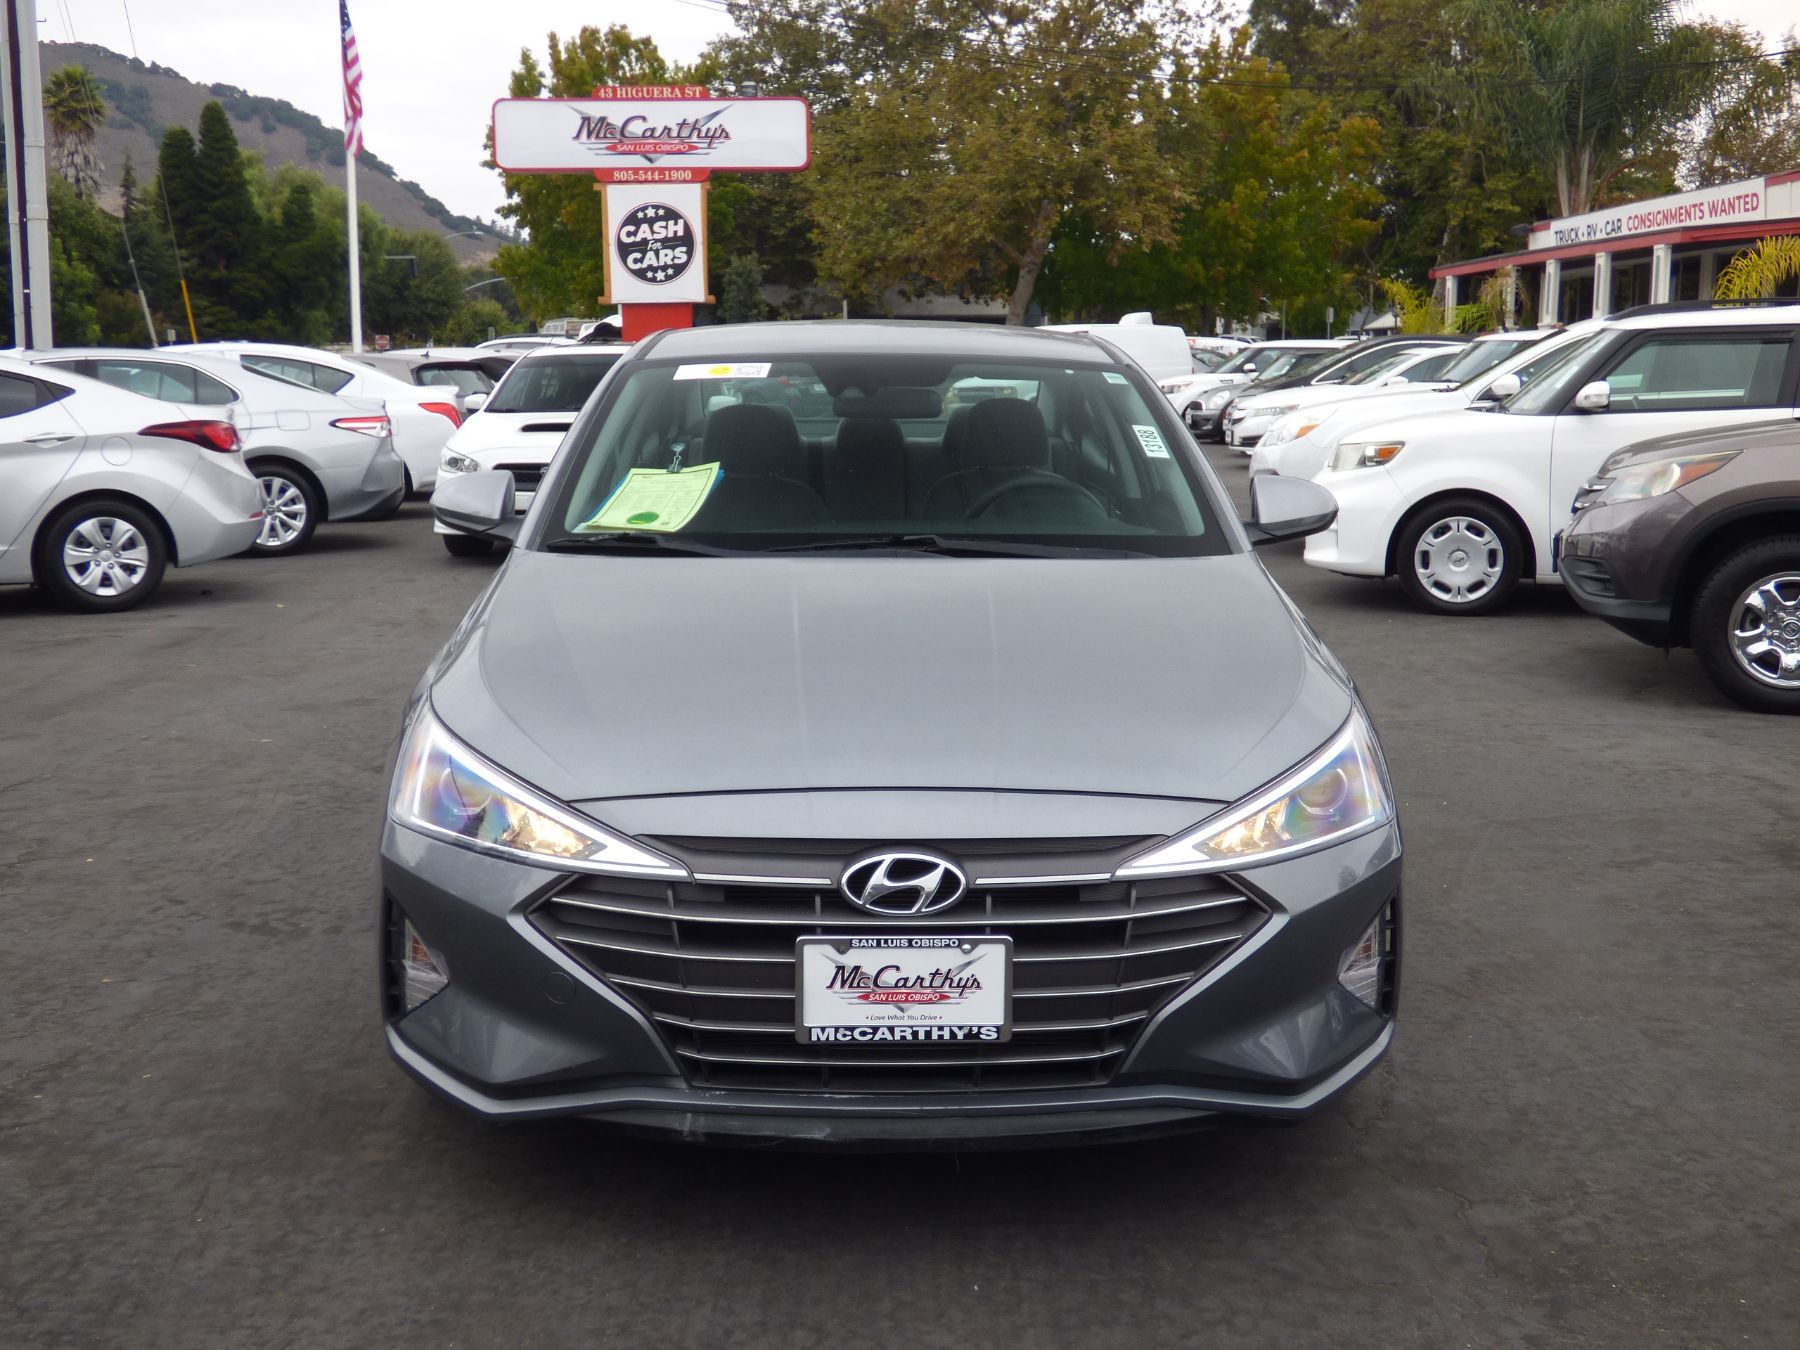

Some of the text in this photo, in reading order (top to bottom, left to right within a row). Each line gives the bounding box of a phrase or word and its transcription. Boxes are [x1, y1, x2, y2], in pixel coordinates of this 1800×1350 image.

[598, 87, 702, 98] 43 HIGUERA ST
[571, 115, 732, 148] McCarthy's
[616, 143, 689, 152] SAN LUIS OBISPO
[613, 170, 692, 181] 805-544-1900
[1554, 192, 1760, 245] TRUCK RV CAR CONSIGNMENTS WANTED
[619, 218, 685, 243] CASH
[647, 239, 663, 251] For
[626, 247, 688, 270] CARS
[851, 939, 959, 947] SAN LUIS OBISPO
[826, 965, 983, 997] McCarthy's
[908, 993, 940, 1001] OBISPO
